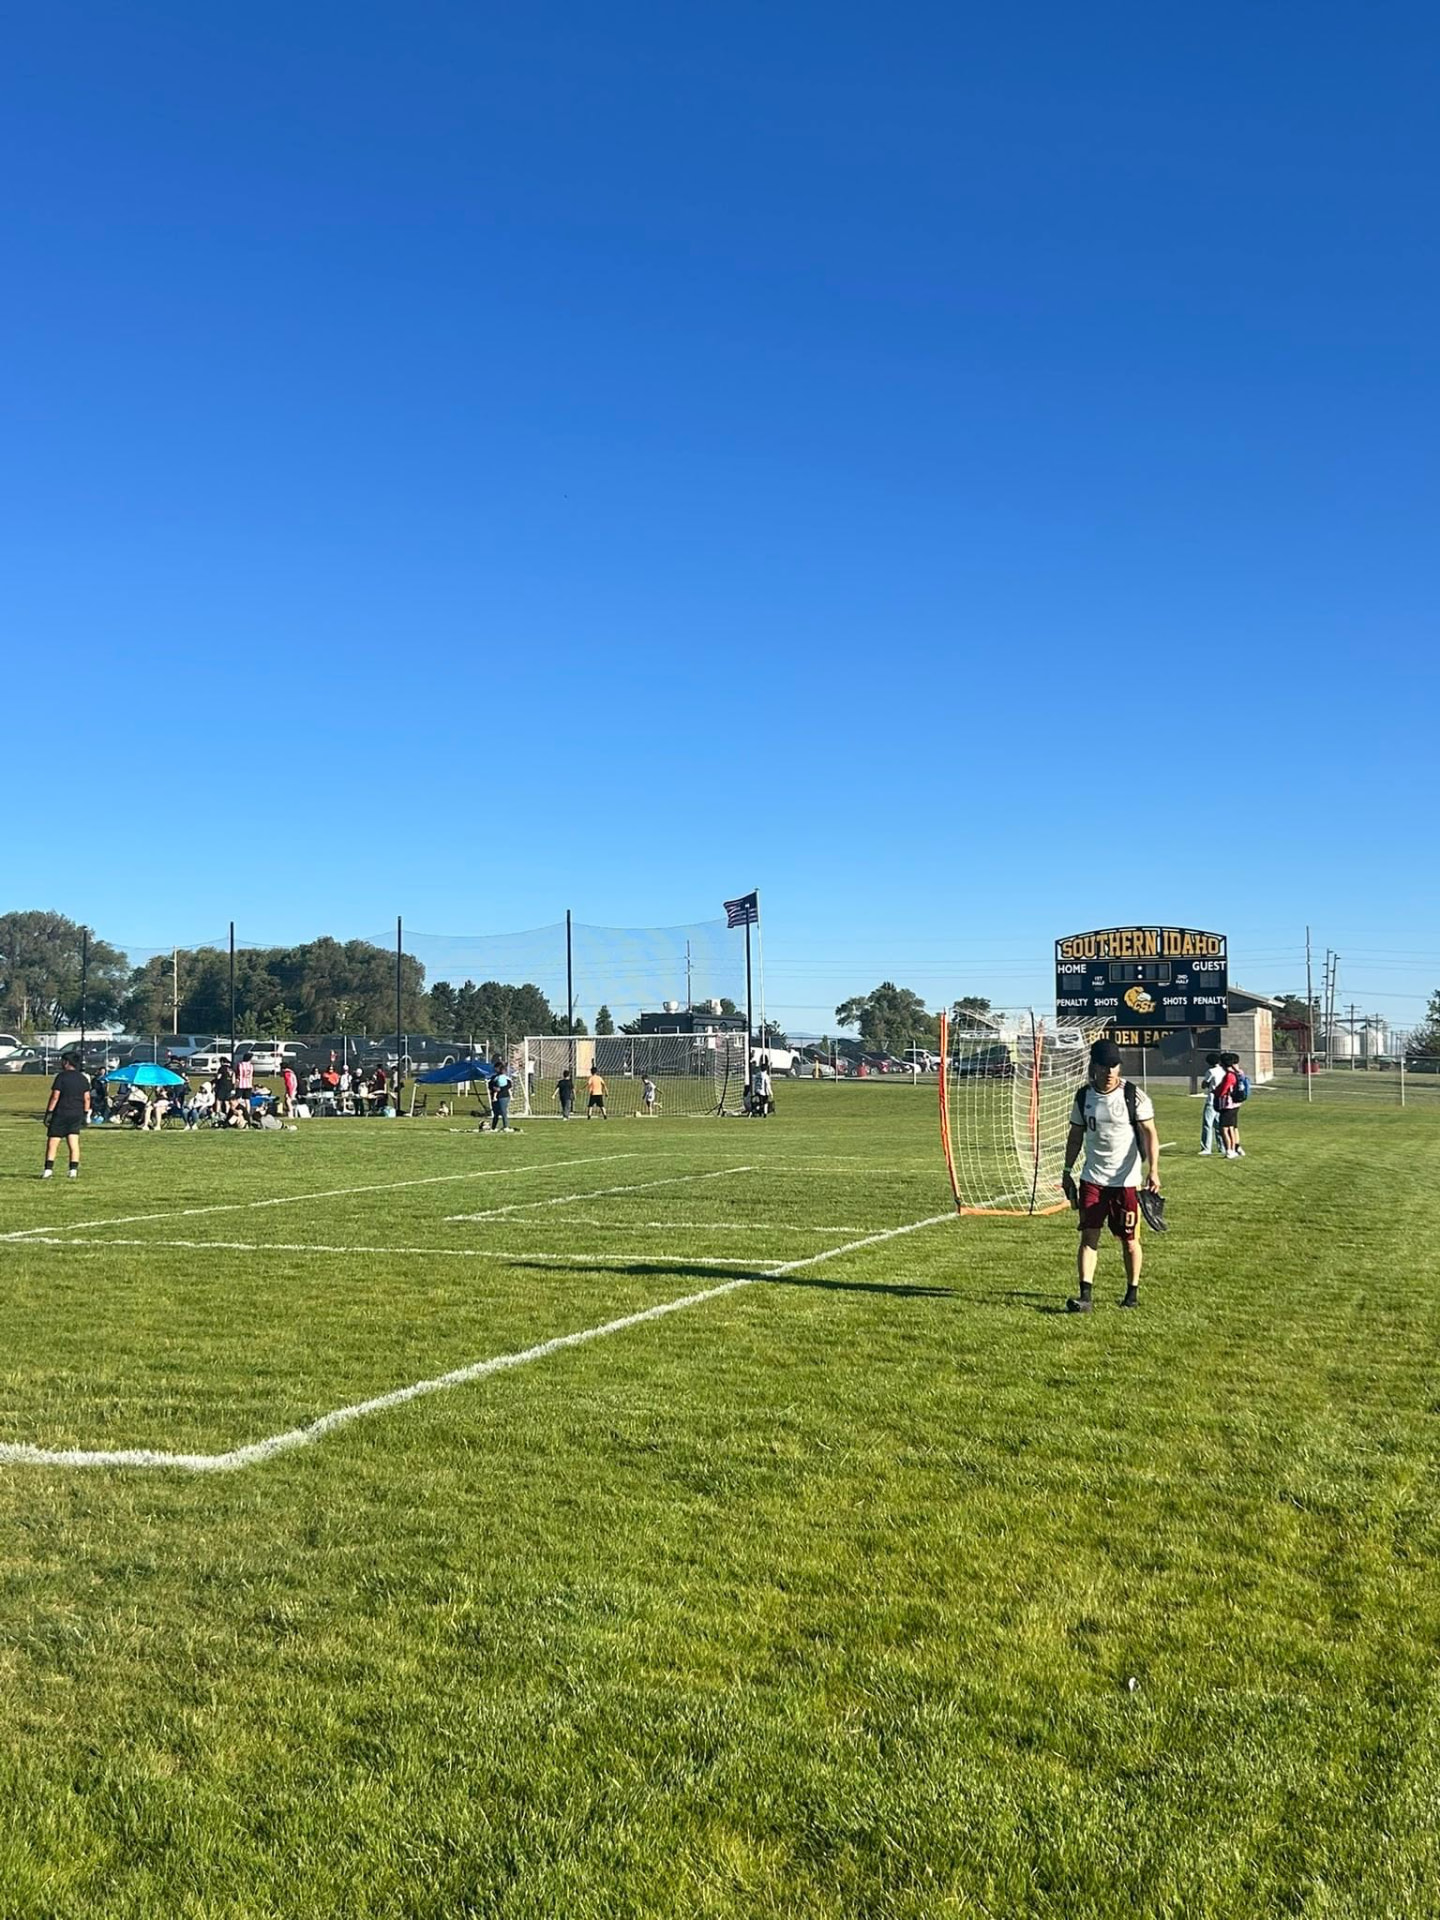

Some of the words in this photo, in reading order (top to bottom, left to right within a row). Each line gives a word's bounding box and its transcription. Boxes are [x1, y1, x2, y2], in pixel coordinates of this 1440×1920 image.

[1062, 930, 1158, 958] SOUTHERN
[1162, 930, 1220, 956] IDAHO
[1057, 964, 1087, 974] HOME
[1192, 961, 1227, 971] GUEST
[1056, 998, 1088, 1007] PENALTY
[1094, 997, 1119, 1007] SHOTS
[1163, 996, 1188, 1006] SHOTS
[1193, 996, 1227, 1005] PENALTY
[1133, 1001, 1157, 1014] CSI
